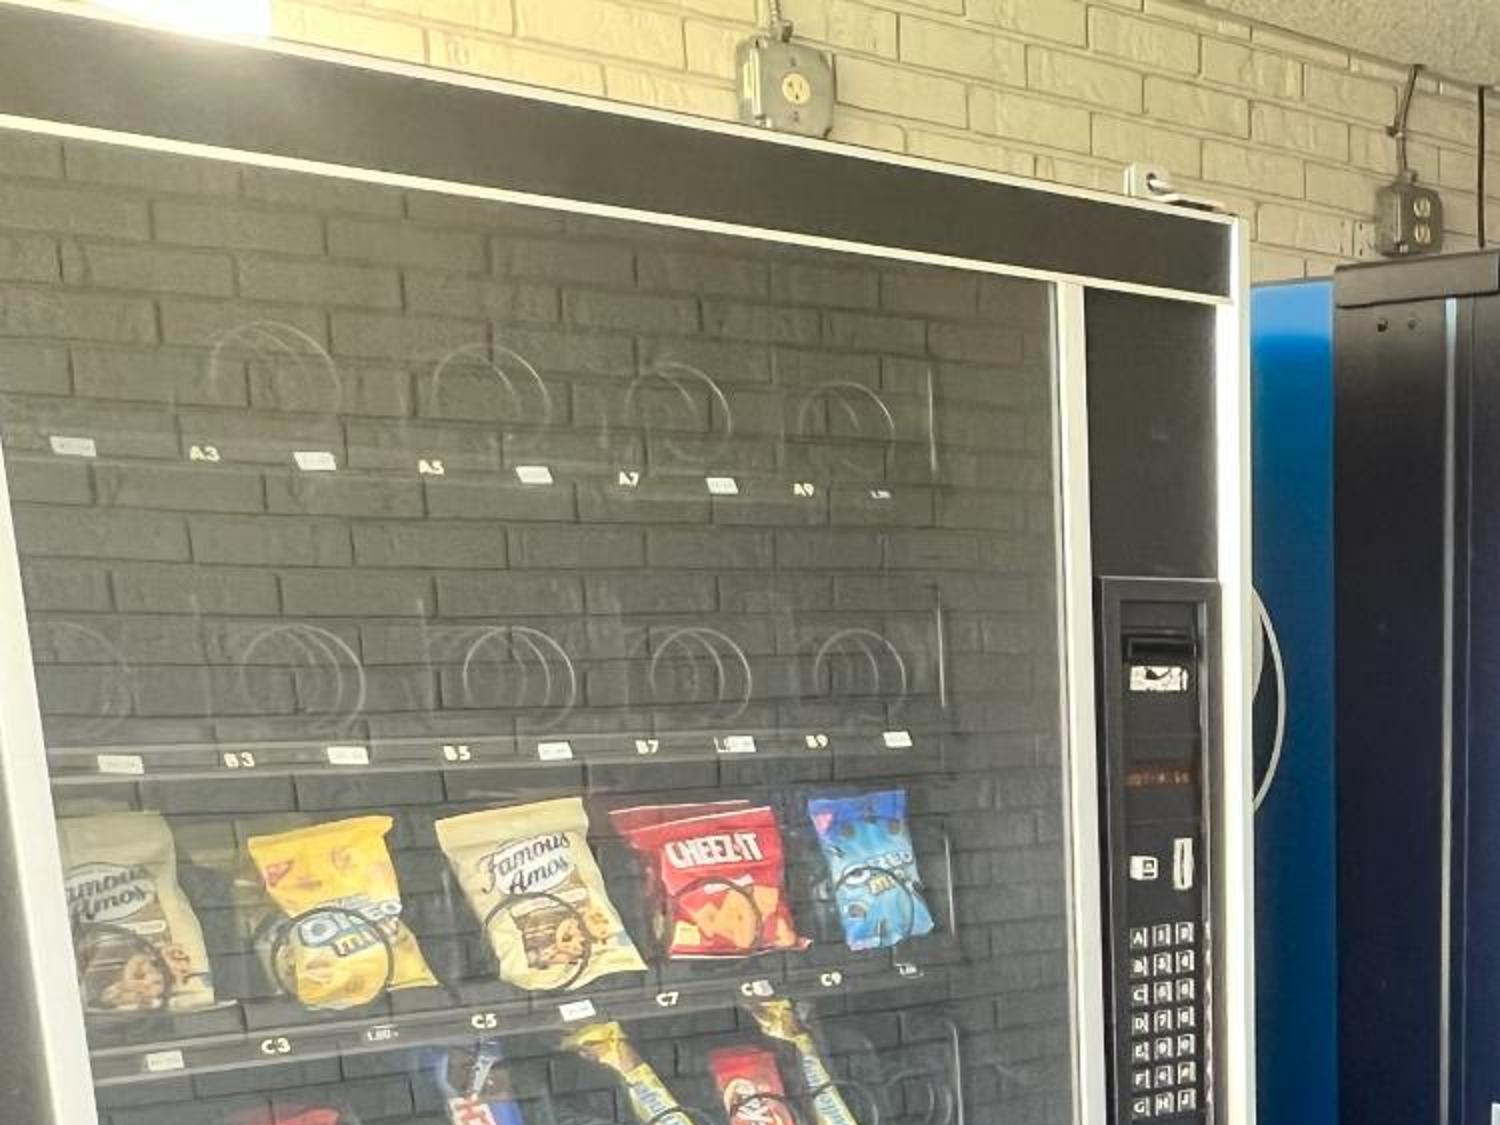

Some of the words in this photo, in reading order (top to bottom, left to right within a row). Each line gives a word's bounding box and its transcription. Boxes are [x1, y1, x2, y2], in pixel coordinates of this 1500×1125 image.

[189, 445, 220, 462] A3
[418, 459, 445, 475] A5
[618, 471, 639, 486] A7
[635, 739, 659, 755] B7
[805, 734, 828, 748] B9
[223, 751, 255, 768] B3
[443, 745, 471, 761] B5
[477, 832, 570, 893] Famous
[509, 857, 568, 893] Amos
[820, 971, 842, 987] C9
[655, 991, 679, 1007] C7
[471, 1013, 497, 1029] C5
[261, 1037, 291, 1055] C3
